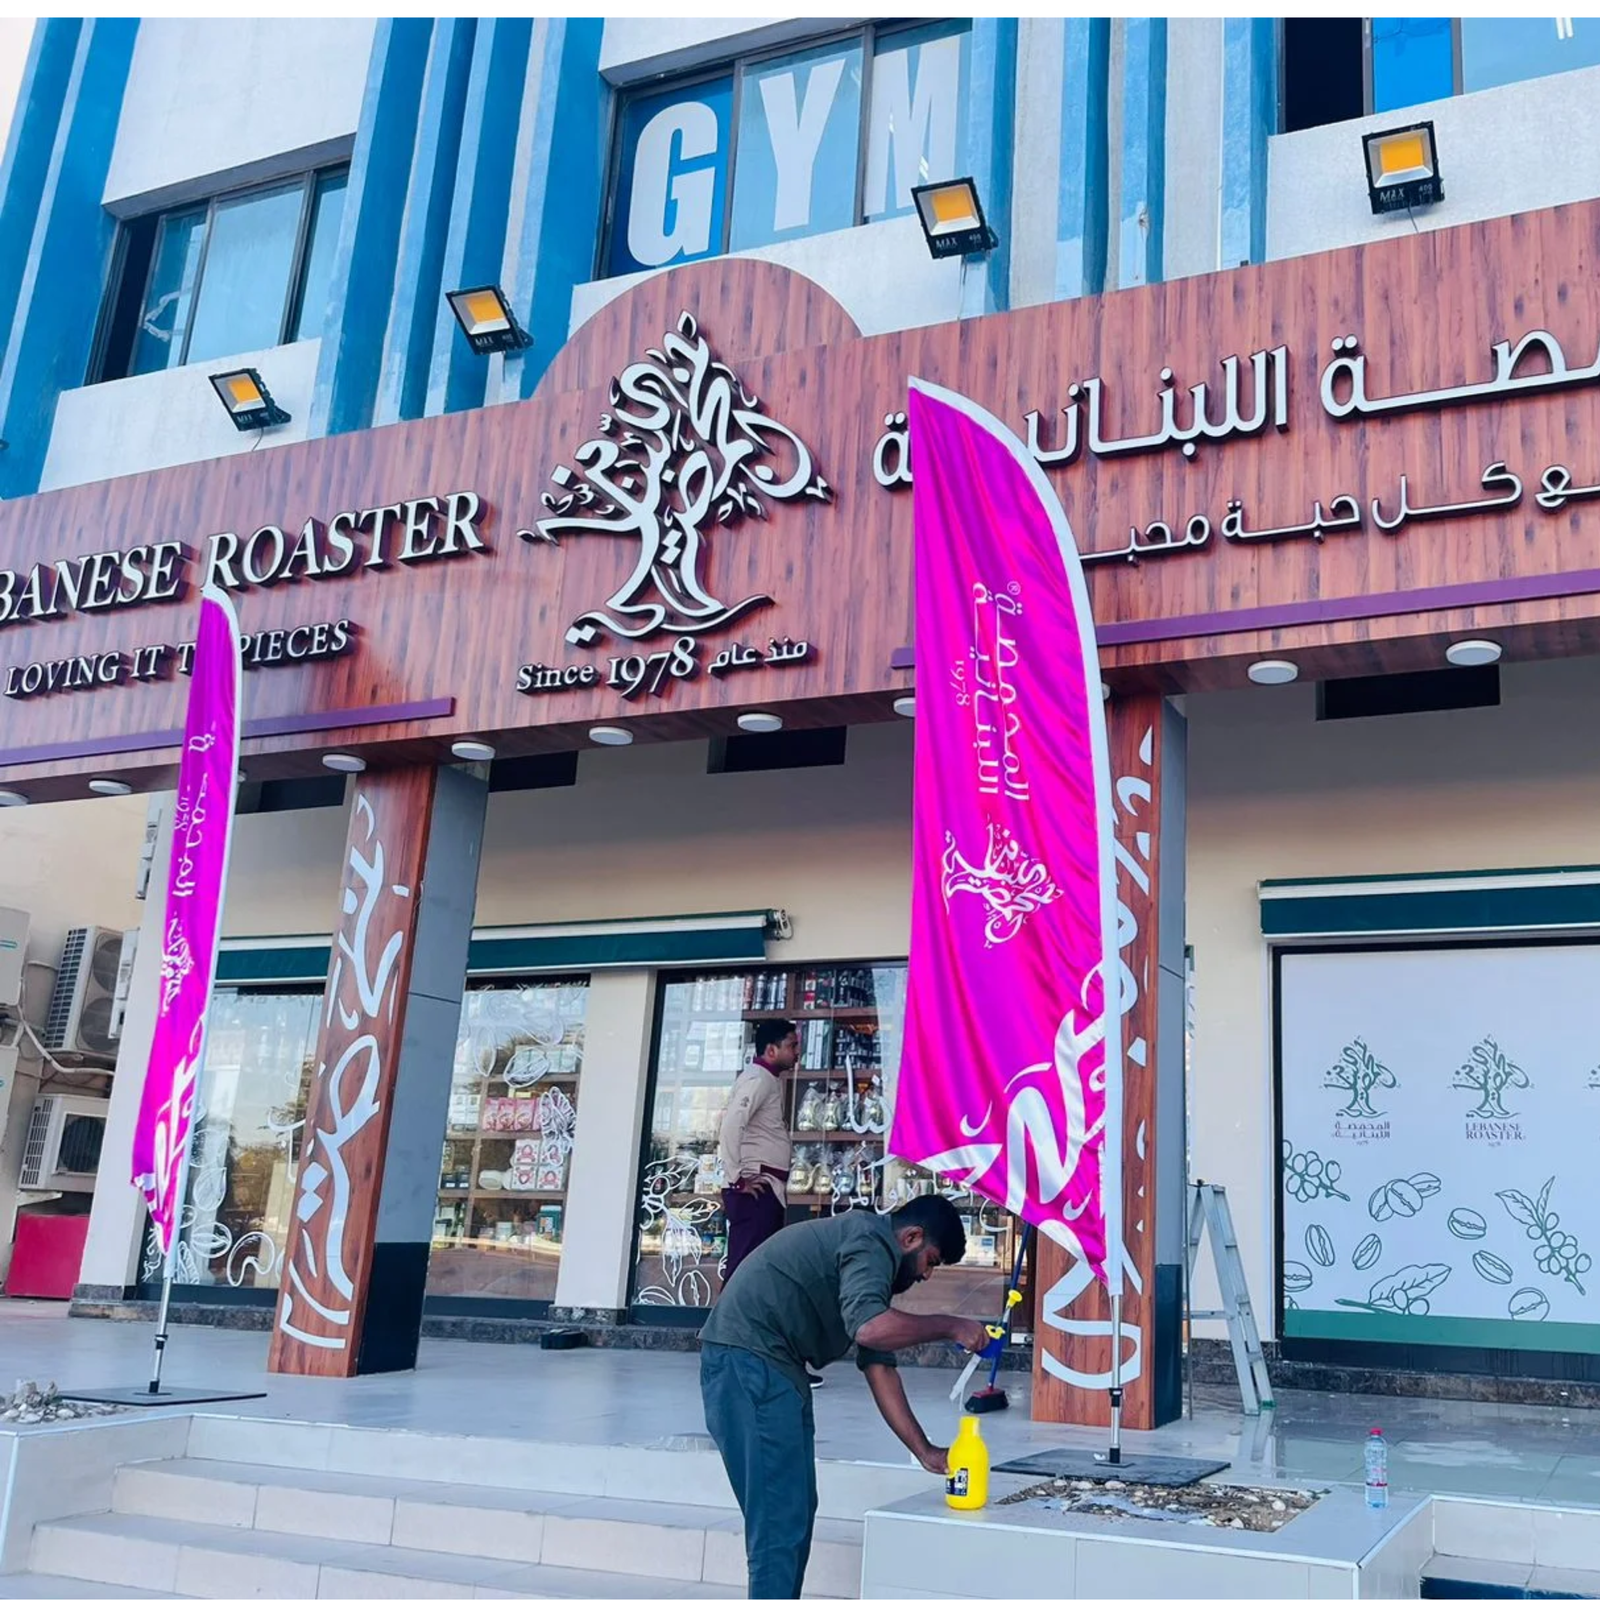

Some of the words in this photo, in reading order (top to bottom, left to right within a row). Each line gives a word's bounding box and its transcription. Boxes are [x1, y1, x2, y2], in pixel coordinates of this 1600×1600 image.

[627, 33, 962, 268] GYM
[1320, 329, 1600, 418] صة
[1221, 494, 1361, 541] حبة
[1373, 461, 1523, 529] كل
[202, 490, 484, 592] ROASTER
[1079, 514, 1211, 563] محب
[5, 652, 121, 695] LOVING
[131, 645, 165, 678] IT
[177, 641, 197, 673] T
[516, 663, 596, 691] Since
[606, 636, 696, 698] 1978
[707, 643, 757, 675] عام
[764, 637, 808, 663] منذ
[949, 660, 971, 706] 1978
[969, 581, 1000, 795] اللبنانية
[995, 592, 1030, 801] المحمصة
